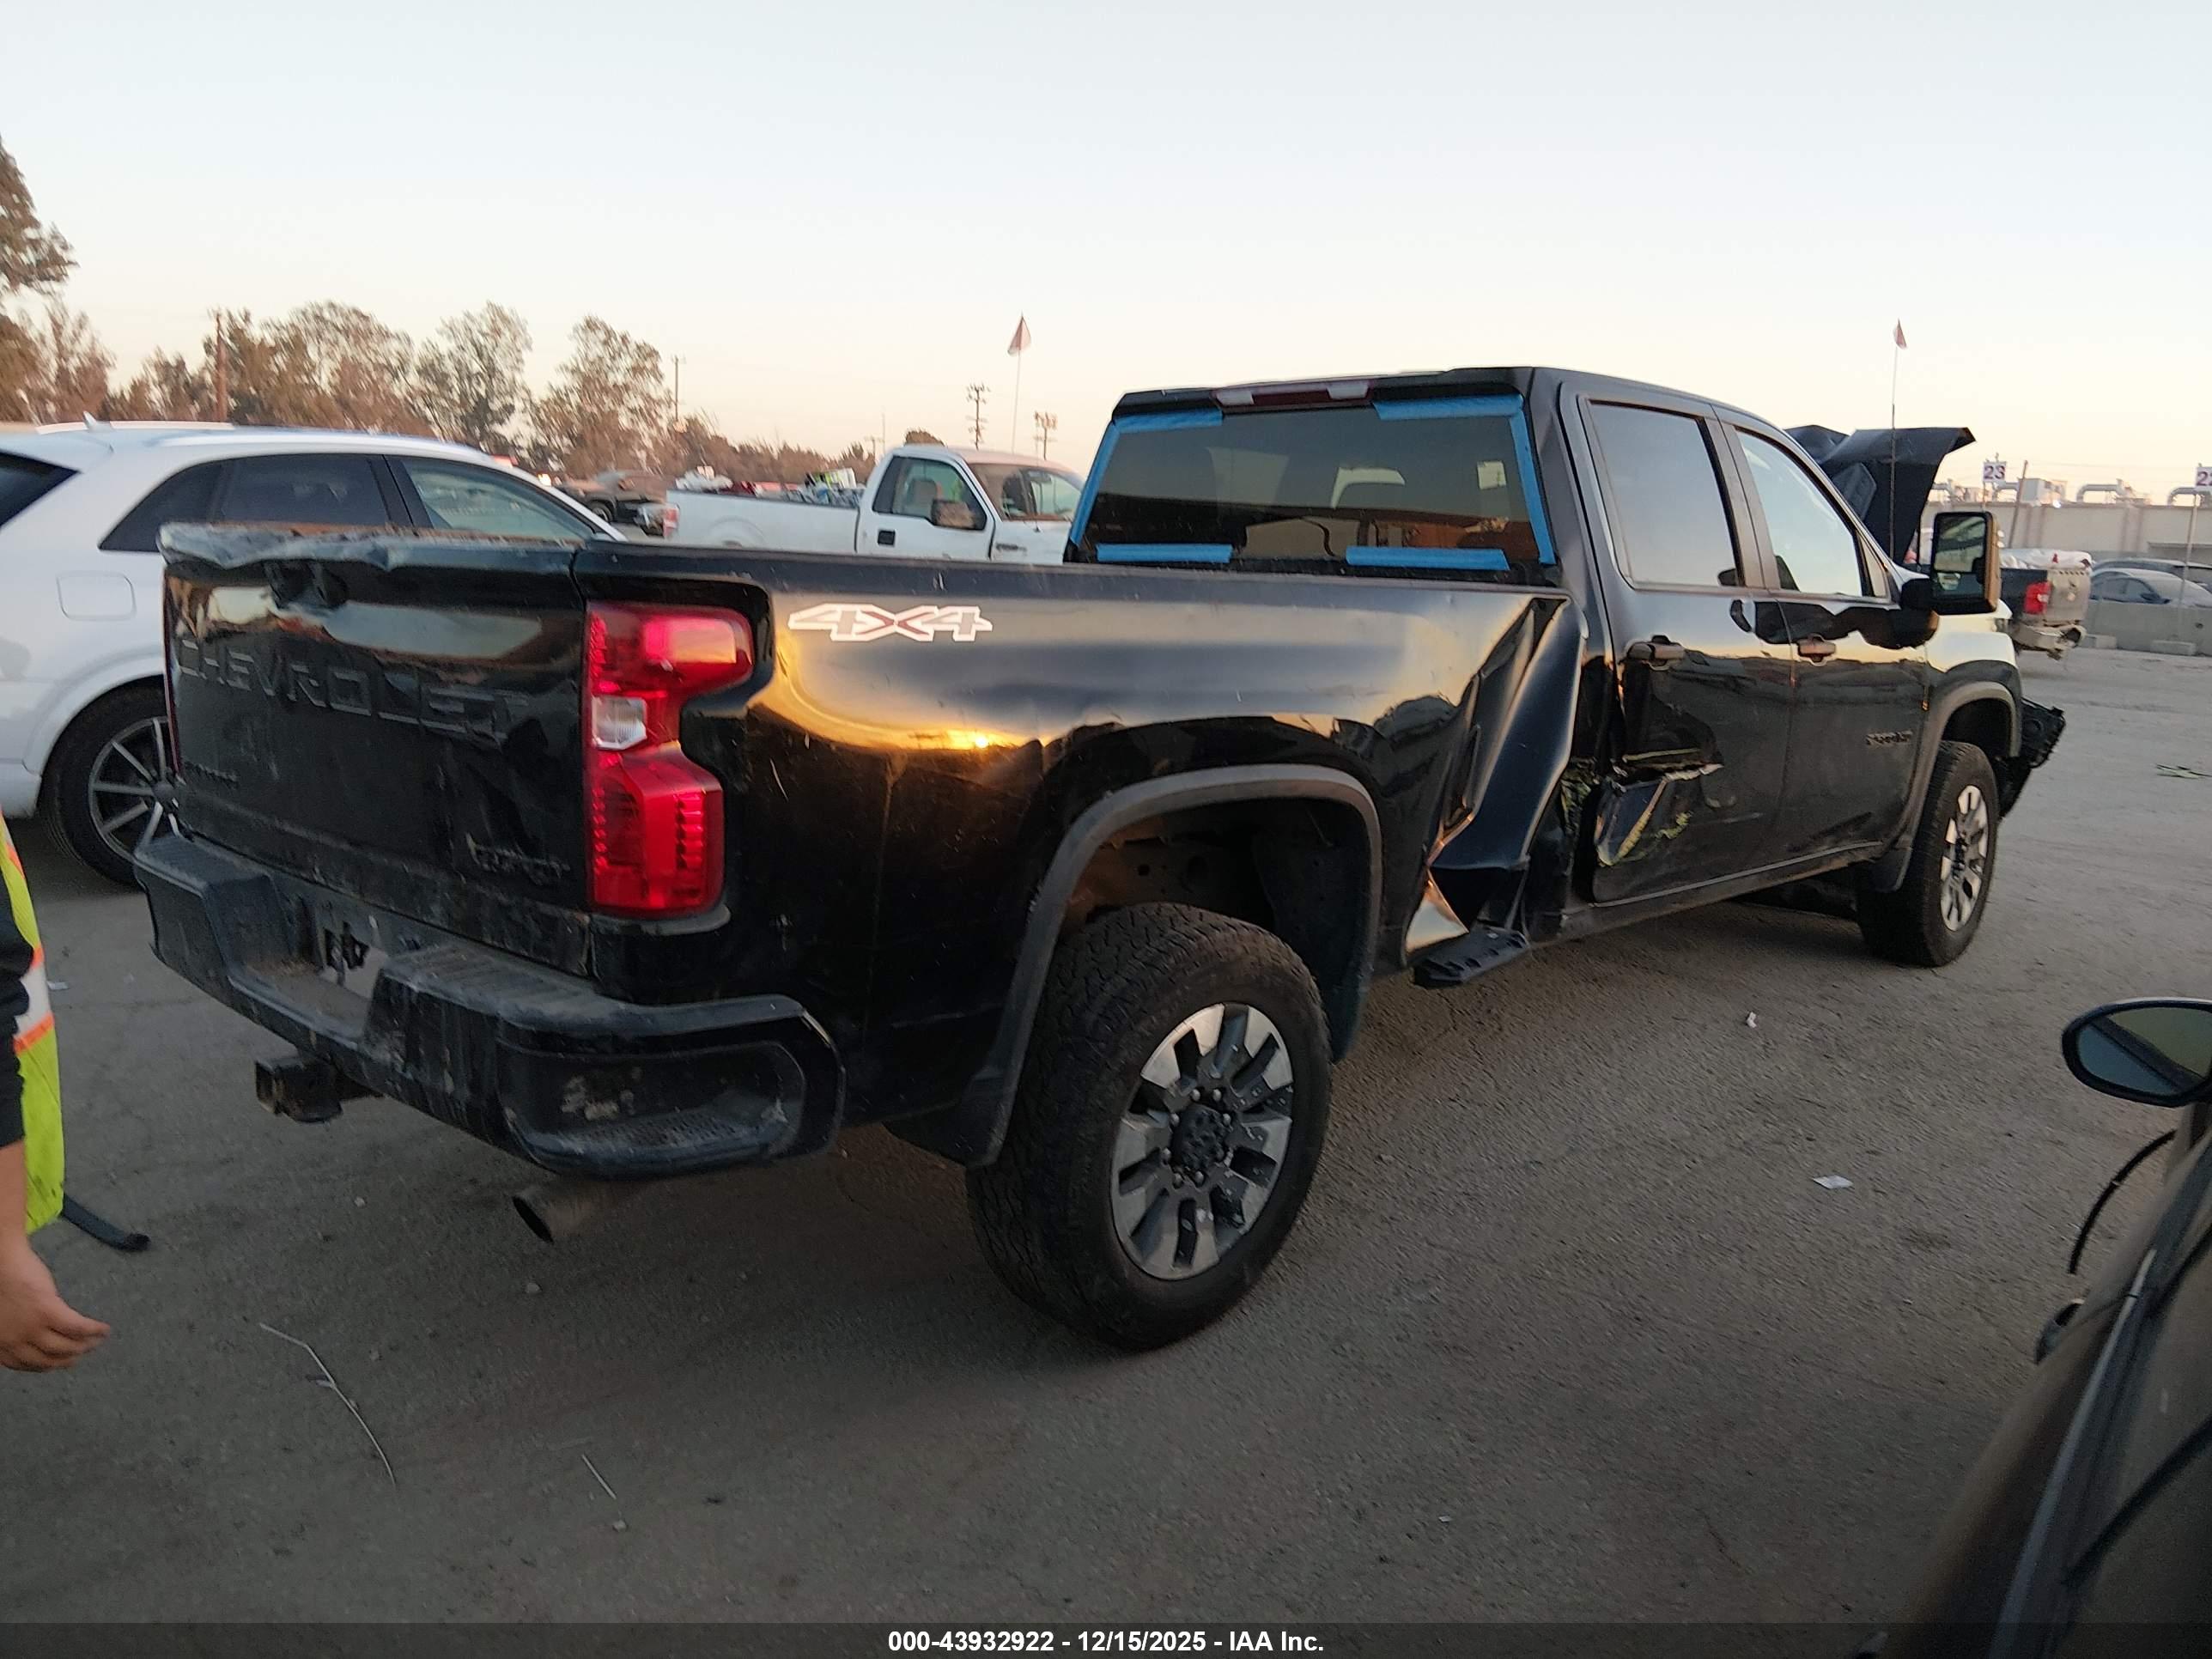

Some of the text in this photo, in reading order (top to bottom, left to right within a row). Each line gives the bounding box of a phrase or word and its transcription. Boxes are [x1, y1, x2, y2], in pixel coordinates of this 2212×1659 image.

[1984, 465, 2006, 480] 23
[2196, 471, 2212, 487] 2
[178, 637, 531, 744] CHEVROLET
